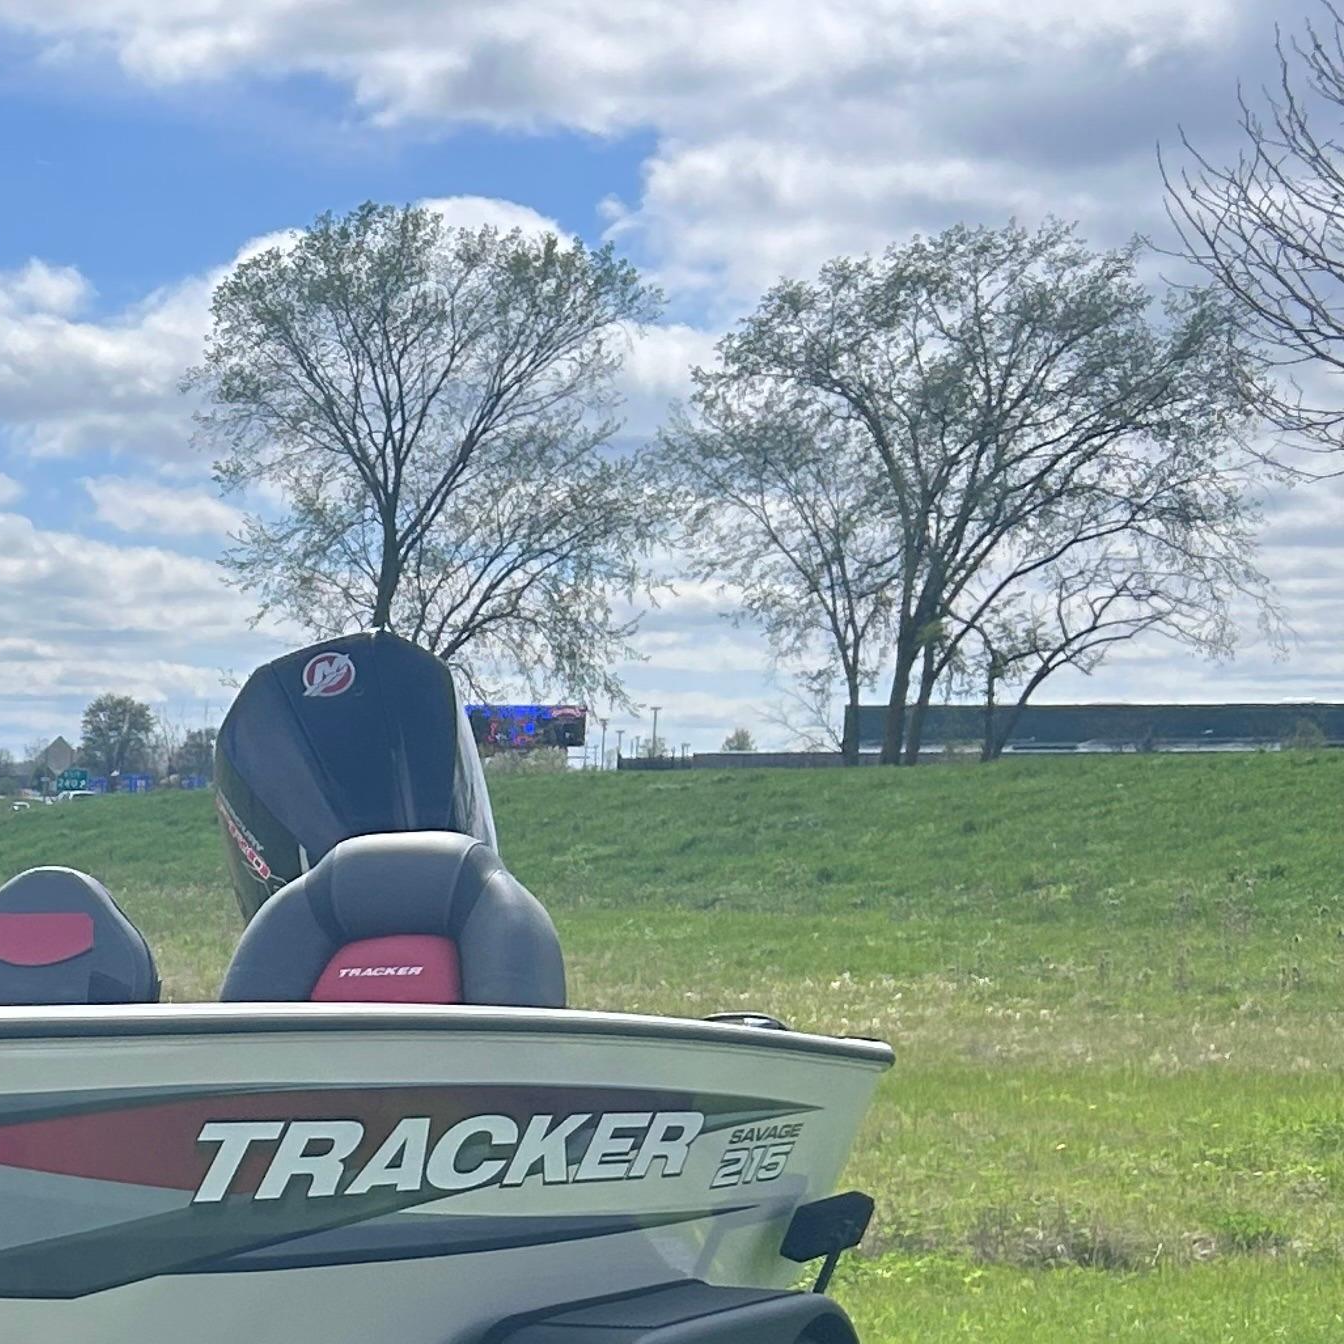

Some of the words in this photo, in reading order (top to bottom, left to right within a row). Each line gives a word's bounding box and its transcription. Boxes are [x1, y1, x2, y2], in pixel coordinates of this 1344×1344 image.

[338, 966, 424, 978] TRACKER
[728, 1122, 805, 1145] SAVAGE
[192, 1110, 705, 1202] TRACKER
[709, 1140, 796, 1190] 215
